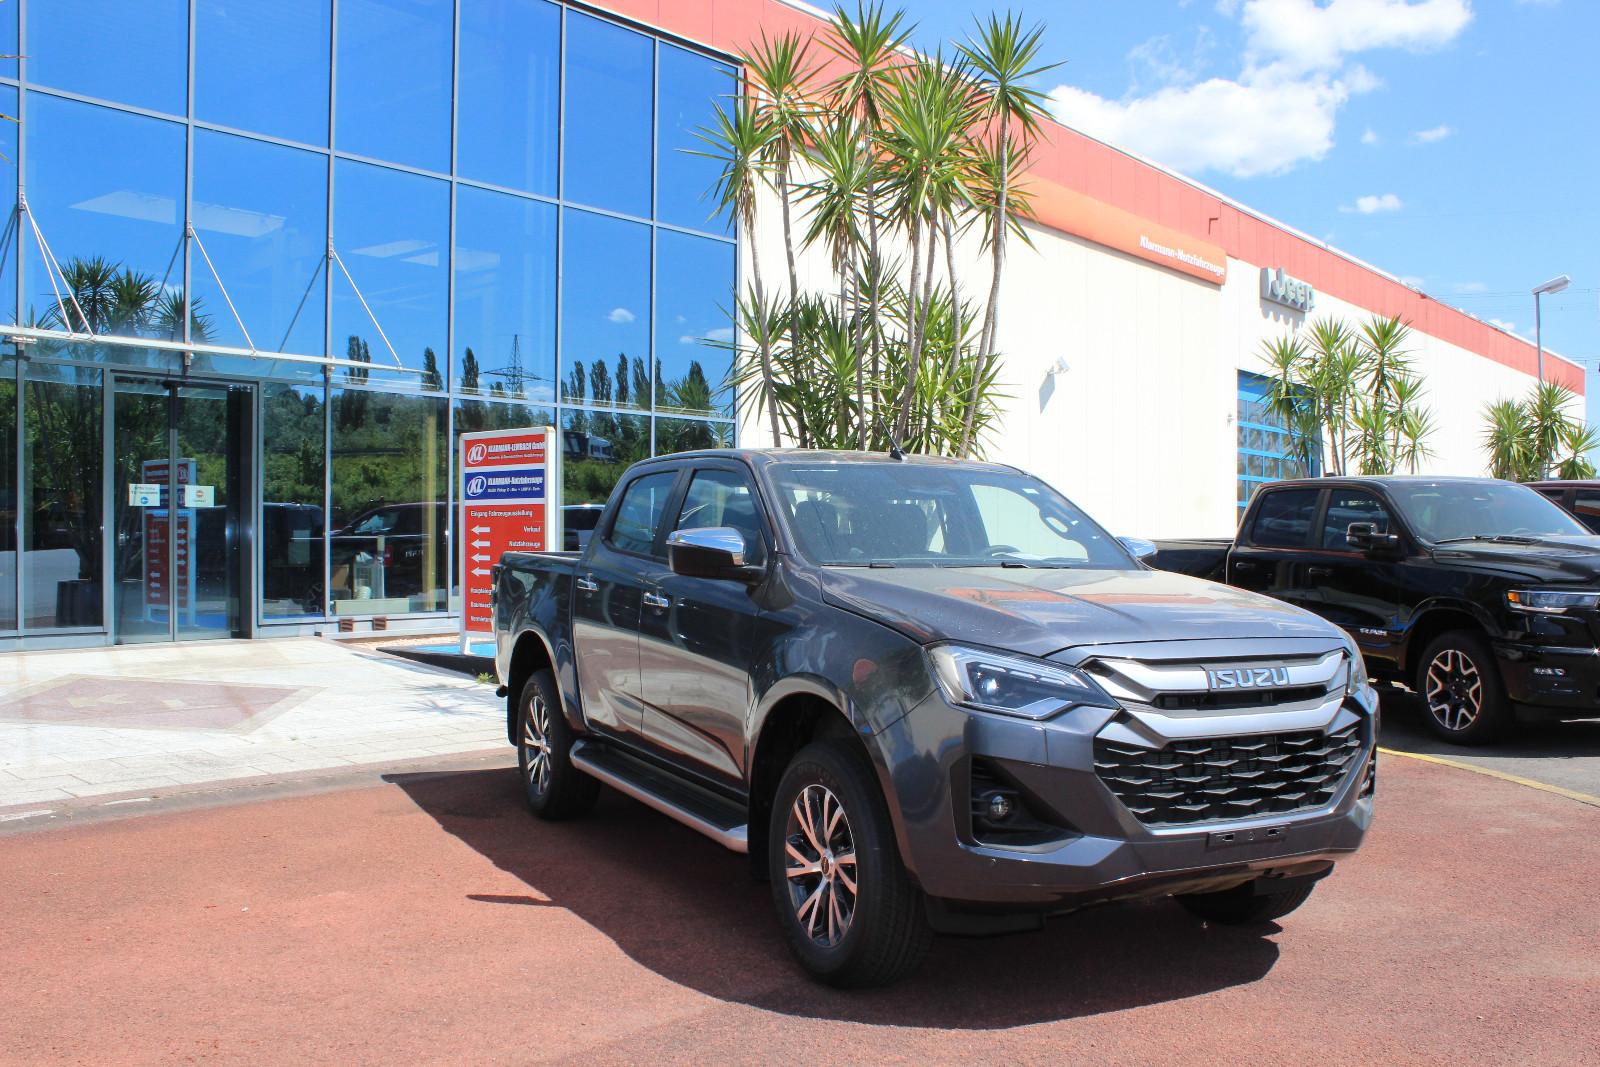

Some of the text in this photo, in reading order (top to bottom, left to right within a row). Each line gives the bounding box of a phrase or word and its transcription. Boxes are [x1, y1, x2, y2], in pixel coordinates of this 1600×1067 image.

[1268, 267, 1314, 311] Jeep
[470, 510, 488, 518] Eingang
[523, 525, 541, 533] Verkauf
[508, 540, 541, 549] Nutzfahrzeuge
[1208, 666, 1289, 689] ISUZU
